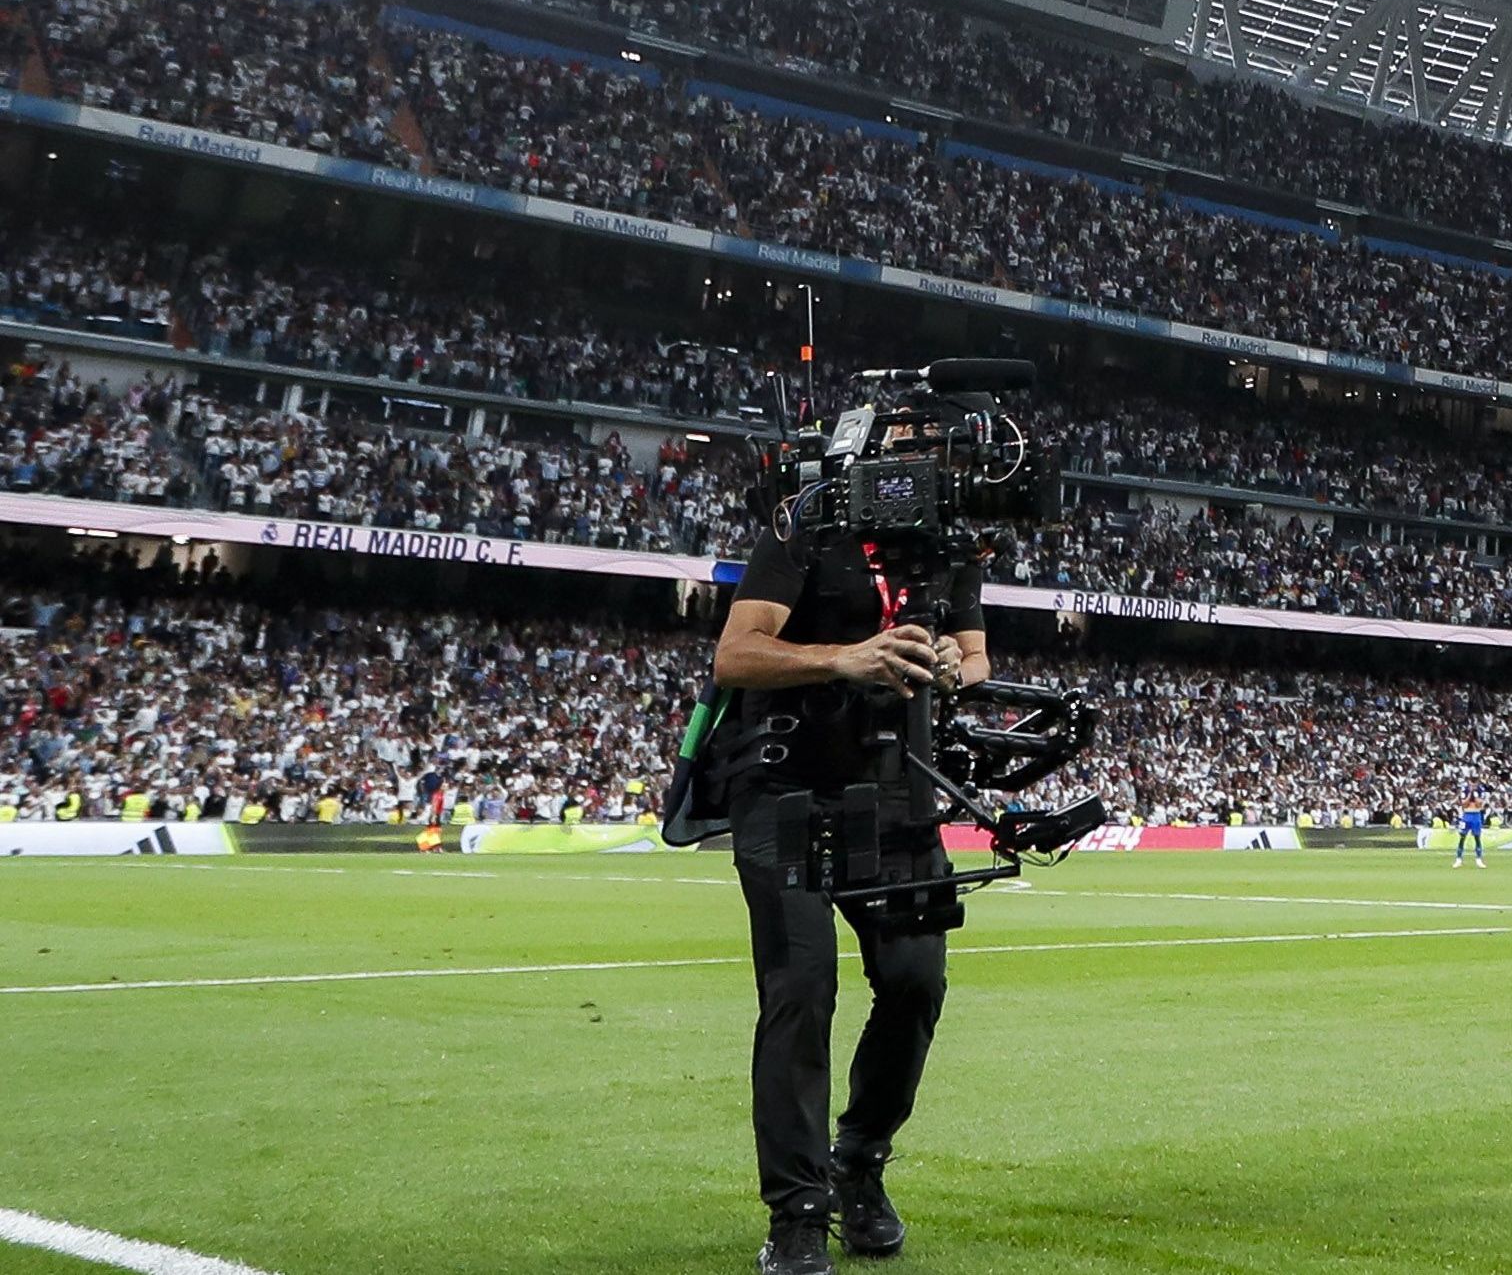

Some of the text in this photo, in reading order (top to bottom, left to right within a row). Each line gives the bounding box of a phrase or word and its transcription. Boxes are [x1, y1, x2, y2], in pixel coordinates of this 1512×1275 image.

[138, 125, 261, 161] Real Madrid
[372, 168, 475, 202] Real Madrid
[573, 210, 668, 241] Real Madrid
[758, 244, 841, 272] Real Madrid
[919, 278, 999, 303] Real Madrid
[1069, 304, 1136, 329] Real Madrid
[1201, 332, 1268, 355] Real Madrid
[294, 523, 357, 553] REAL
[368, 530, 468, 562] MADRID
[1074, 593, 1113, 615] REAL
[1120, 597, 1182, 621] MADRID
